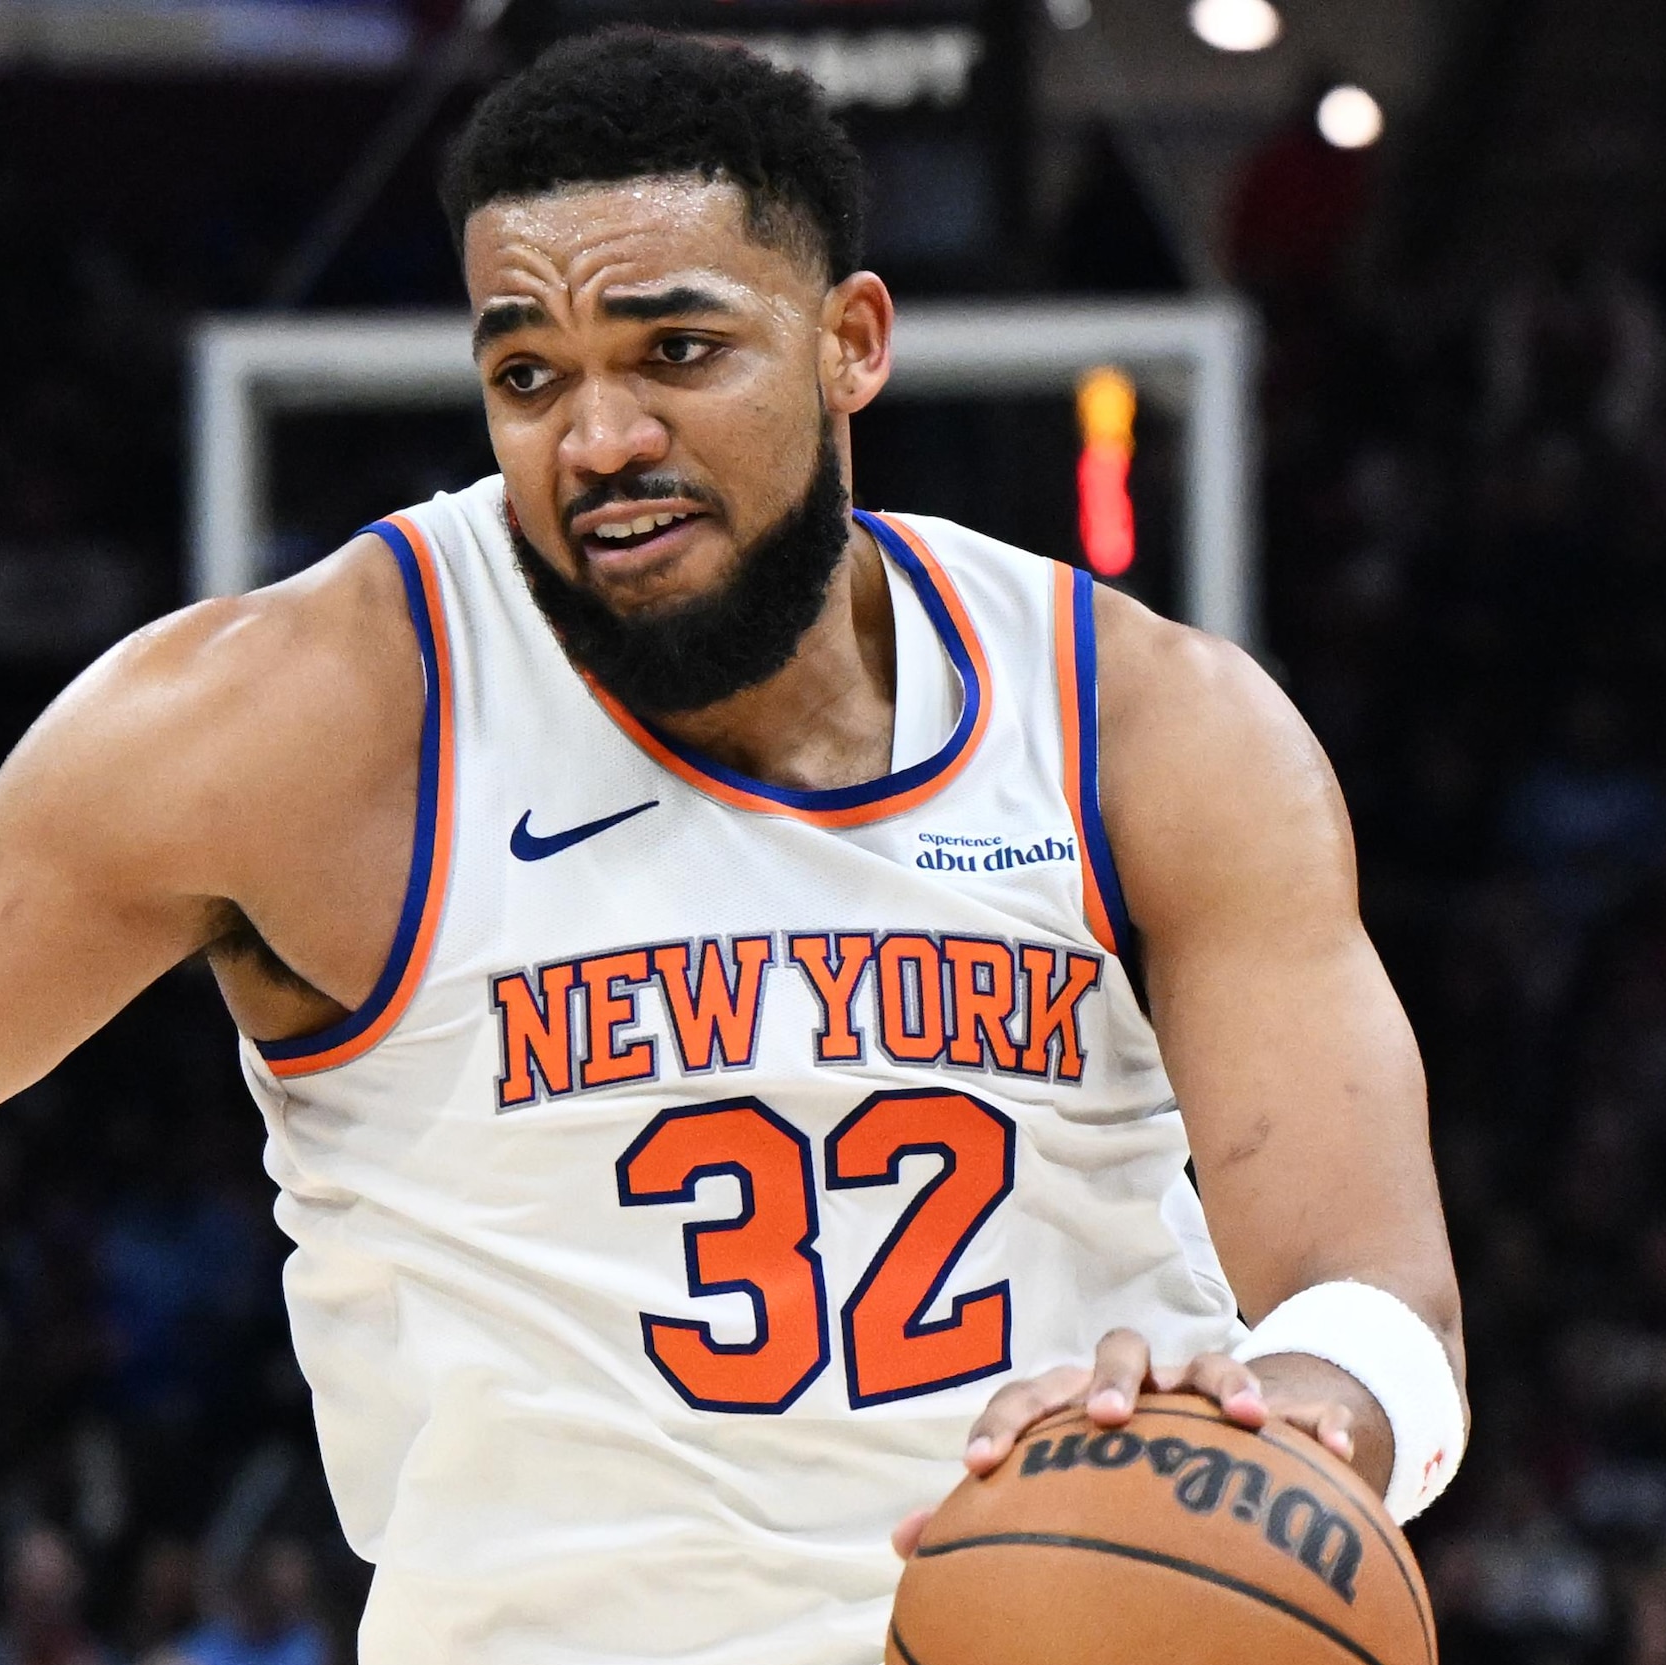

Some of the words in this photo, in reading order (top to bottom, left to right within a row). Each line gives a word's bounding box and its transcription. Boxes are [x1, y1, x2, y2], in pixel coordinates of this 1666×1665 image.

[916, 847, 977, 873] abu
[983, 836, 1076, 872] dhabi
[918, 832, 1003, 848] experience
[489, 931, 776, 1114] NEW
[789, 929, 1105, 1087] YORK
[616, 1086, 1017, 1415] 32
[1021, 1430, 1364, 1606] Wilson
